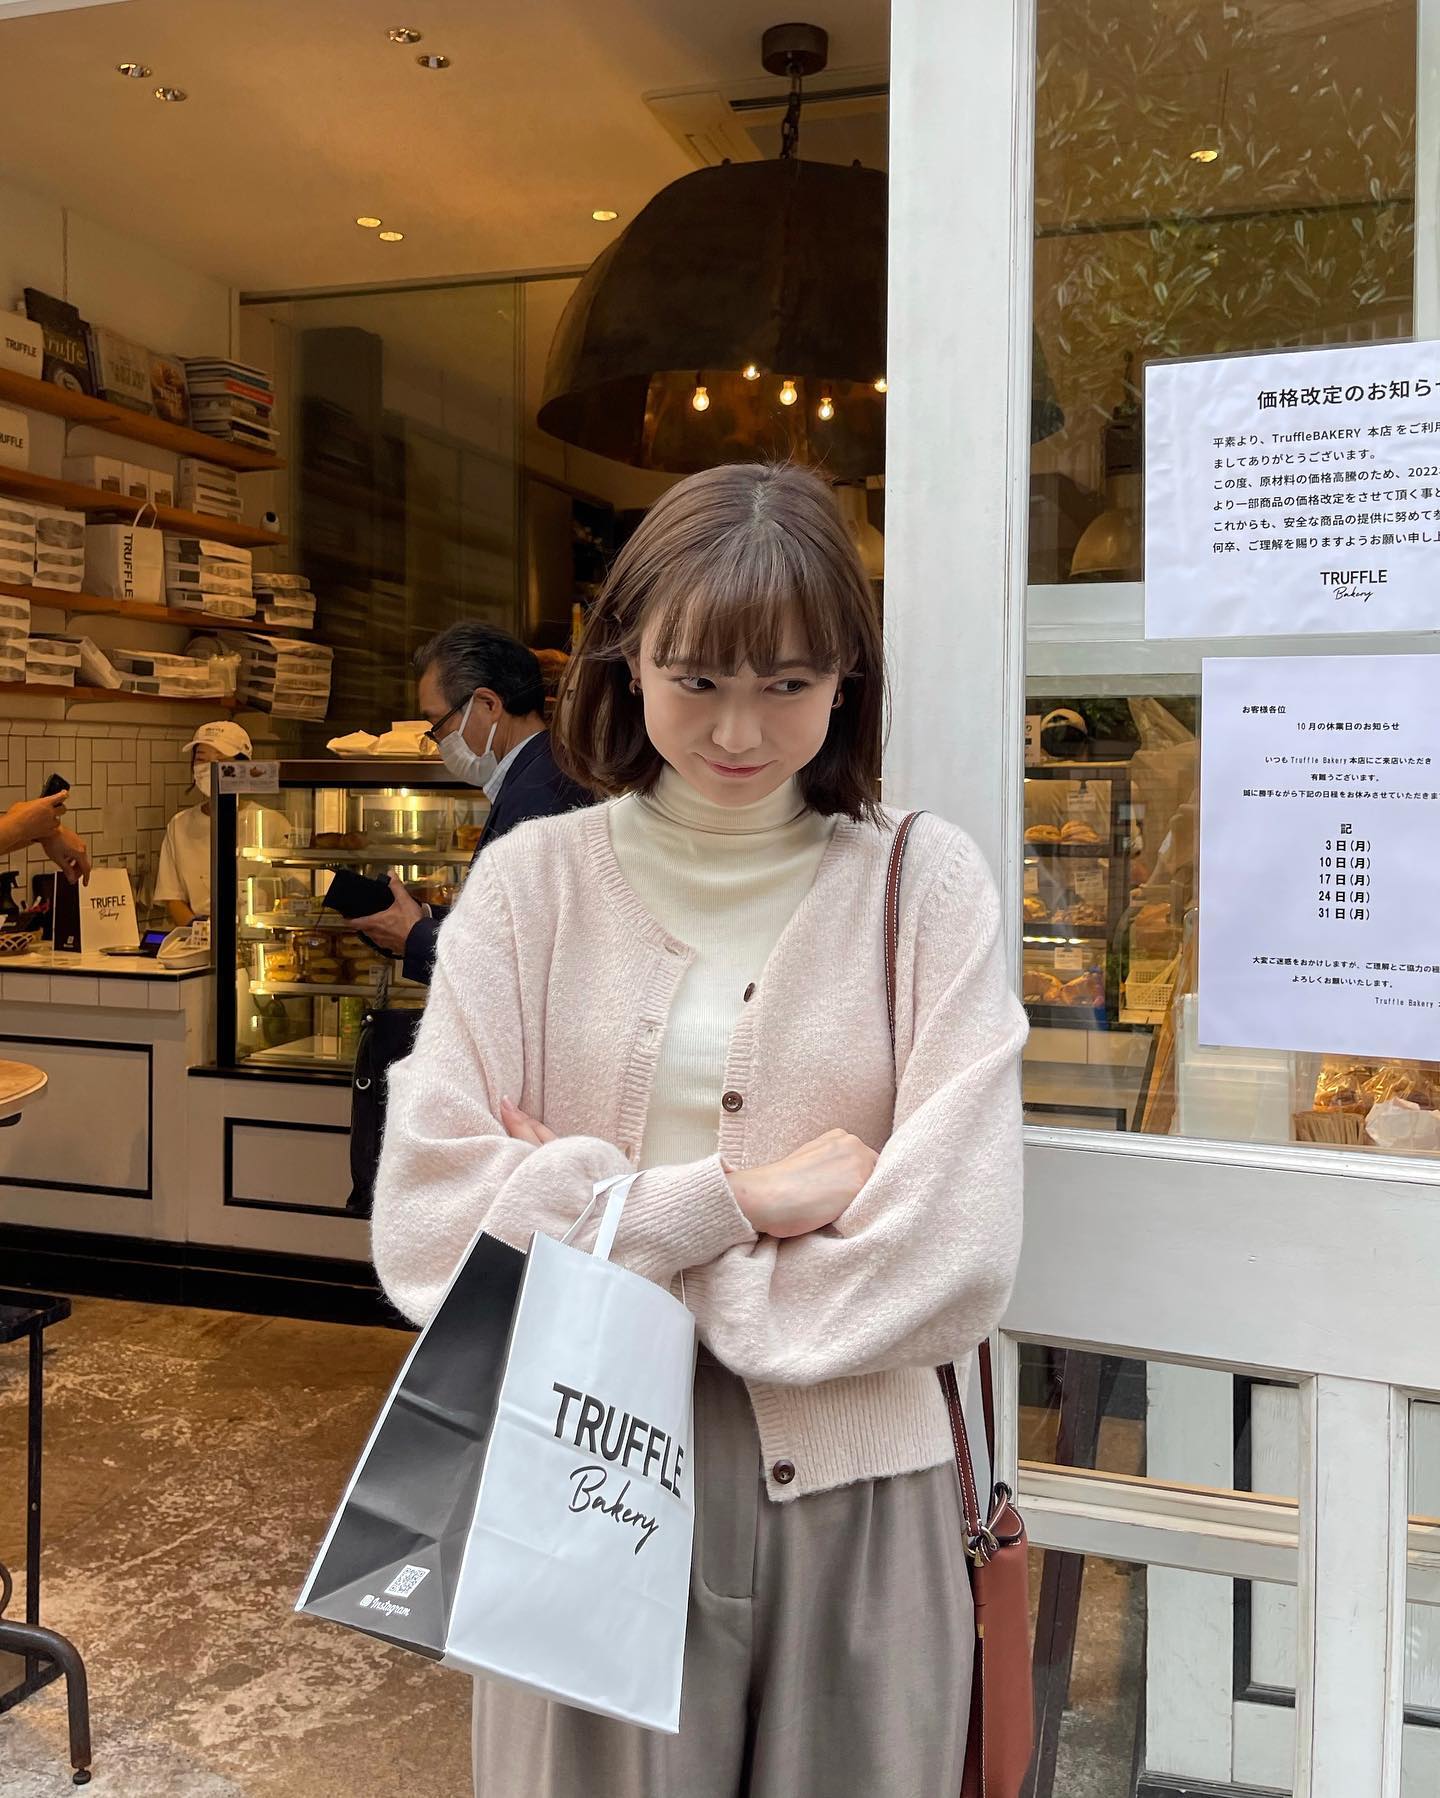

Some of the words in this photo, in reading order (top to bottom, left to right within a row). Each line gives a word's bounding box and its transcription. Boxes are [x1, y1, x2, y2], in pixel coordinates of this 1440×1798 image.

[5, 337, 37, 357] TRUFFLE
[1258, 379, 1440, 410] 価格改定のお知ら
[1214, 449, 1376, 469] ましてありがとうございます。
[1214, 466, 1440, 489] この度、原材料の価格高騰のため、2022
[123, 533, 134, 598] TRUFFLE
[1320, 570, 1388, 585] TRUFFLE
[1333, 586, 1373, 602] Bakery
[1242, 705, 1287, 714] お客様各位
[1340, 823, 1353, 835] 記
[90, 895, 126, 909] TRUFFLE
[1375, 996, 1404, 1006] Truffle
[1408, 999, 1434, 1009] Bakery
[552, 1381, 684, 1499] TRUFFLE
[568, 1465, 660, 1556] Bakery
[370, 1596, 411, 1616] Instagram
